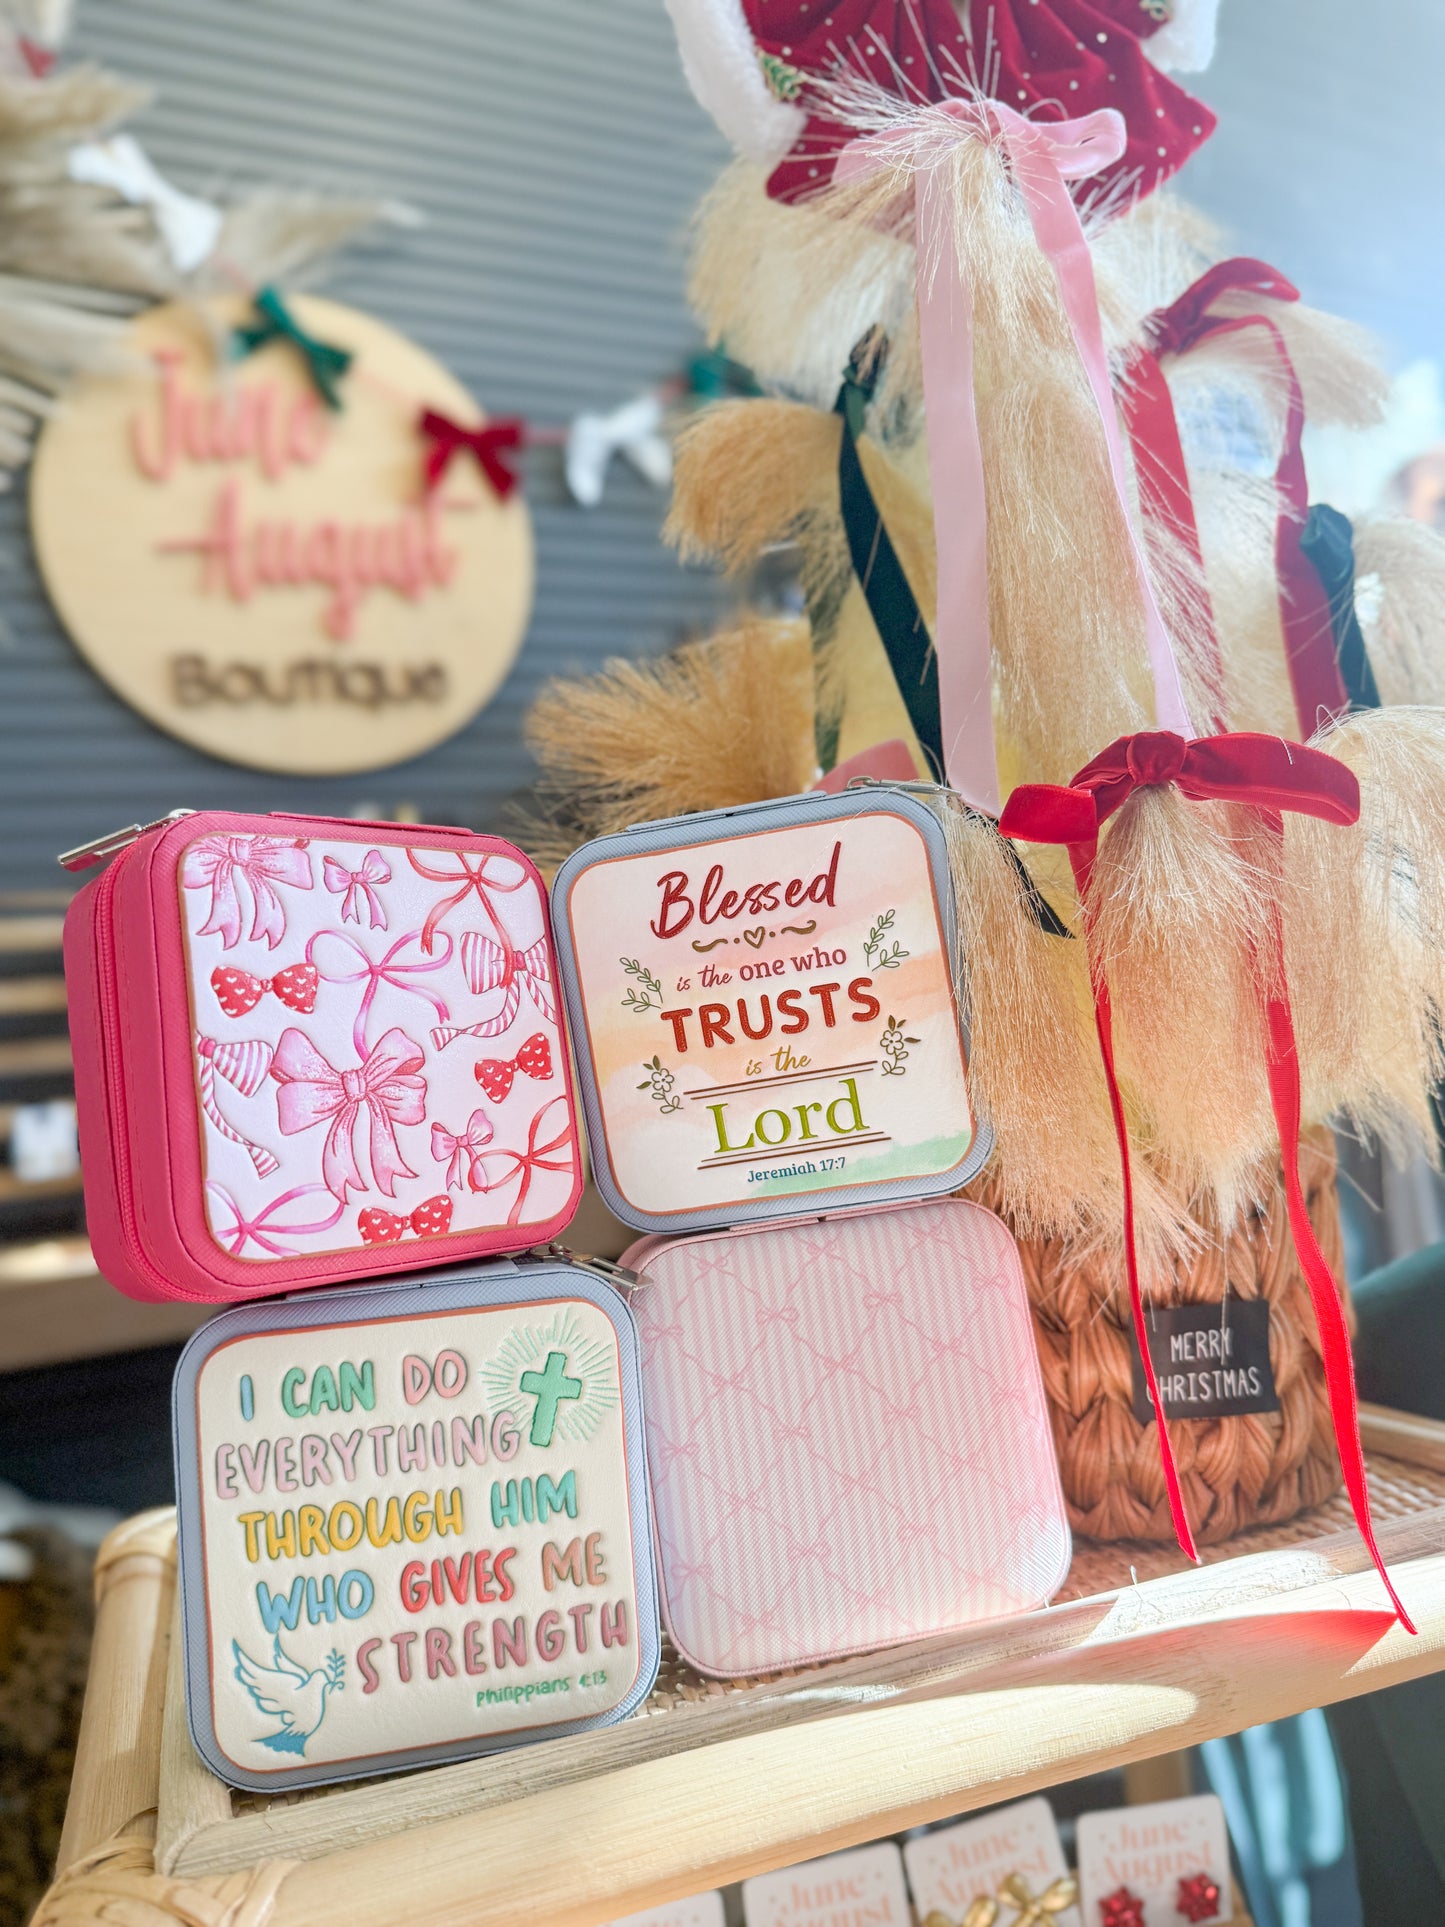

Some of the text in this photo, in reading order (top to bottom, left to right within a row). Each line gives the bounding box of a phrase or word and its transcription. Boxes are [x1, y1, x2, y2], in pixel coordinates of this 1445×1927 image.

[131, 347, 334, 482] June
[154, 480, 480, 642] August
[168, 654, 448, 716] Boutique
[650, 840, 842, 940] Blessed
[676, 946, 847, 993] is the one who
[660, 976, 881, 1054] TRUSTS
[745, 1044, 812, 1077] is the
[706, 1077, 870, 1154] Lord
[747, 1156, 846, 1182] Jeremiah 17:7
[1170, 1327, 1232, 1363] MERRY
[240, 1348, 469, 1422] I CAN DO
[215, 1410, 521, 1499] EVERYTHING
[238, 1469, 578, 1563] THROUGH HIM
[255, 1532, 608, 1634] WHO GIVES ME
[355, 1599, 629, 1695] STRENGTH
